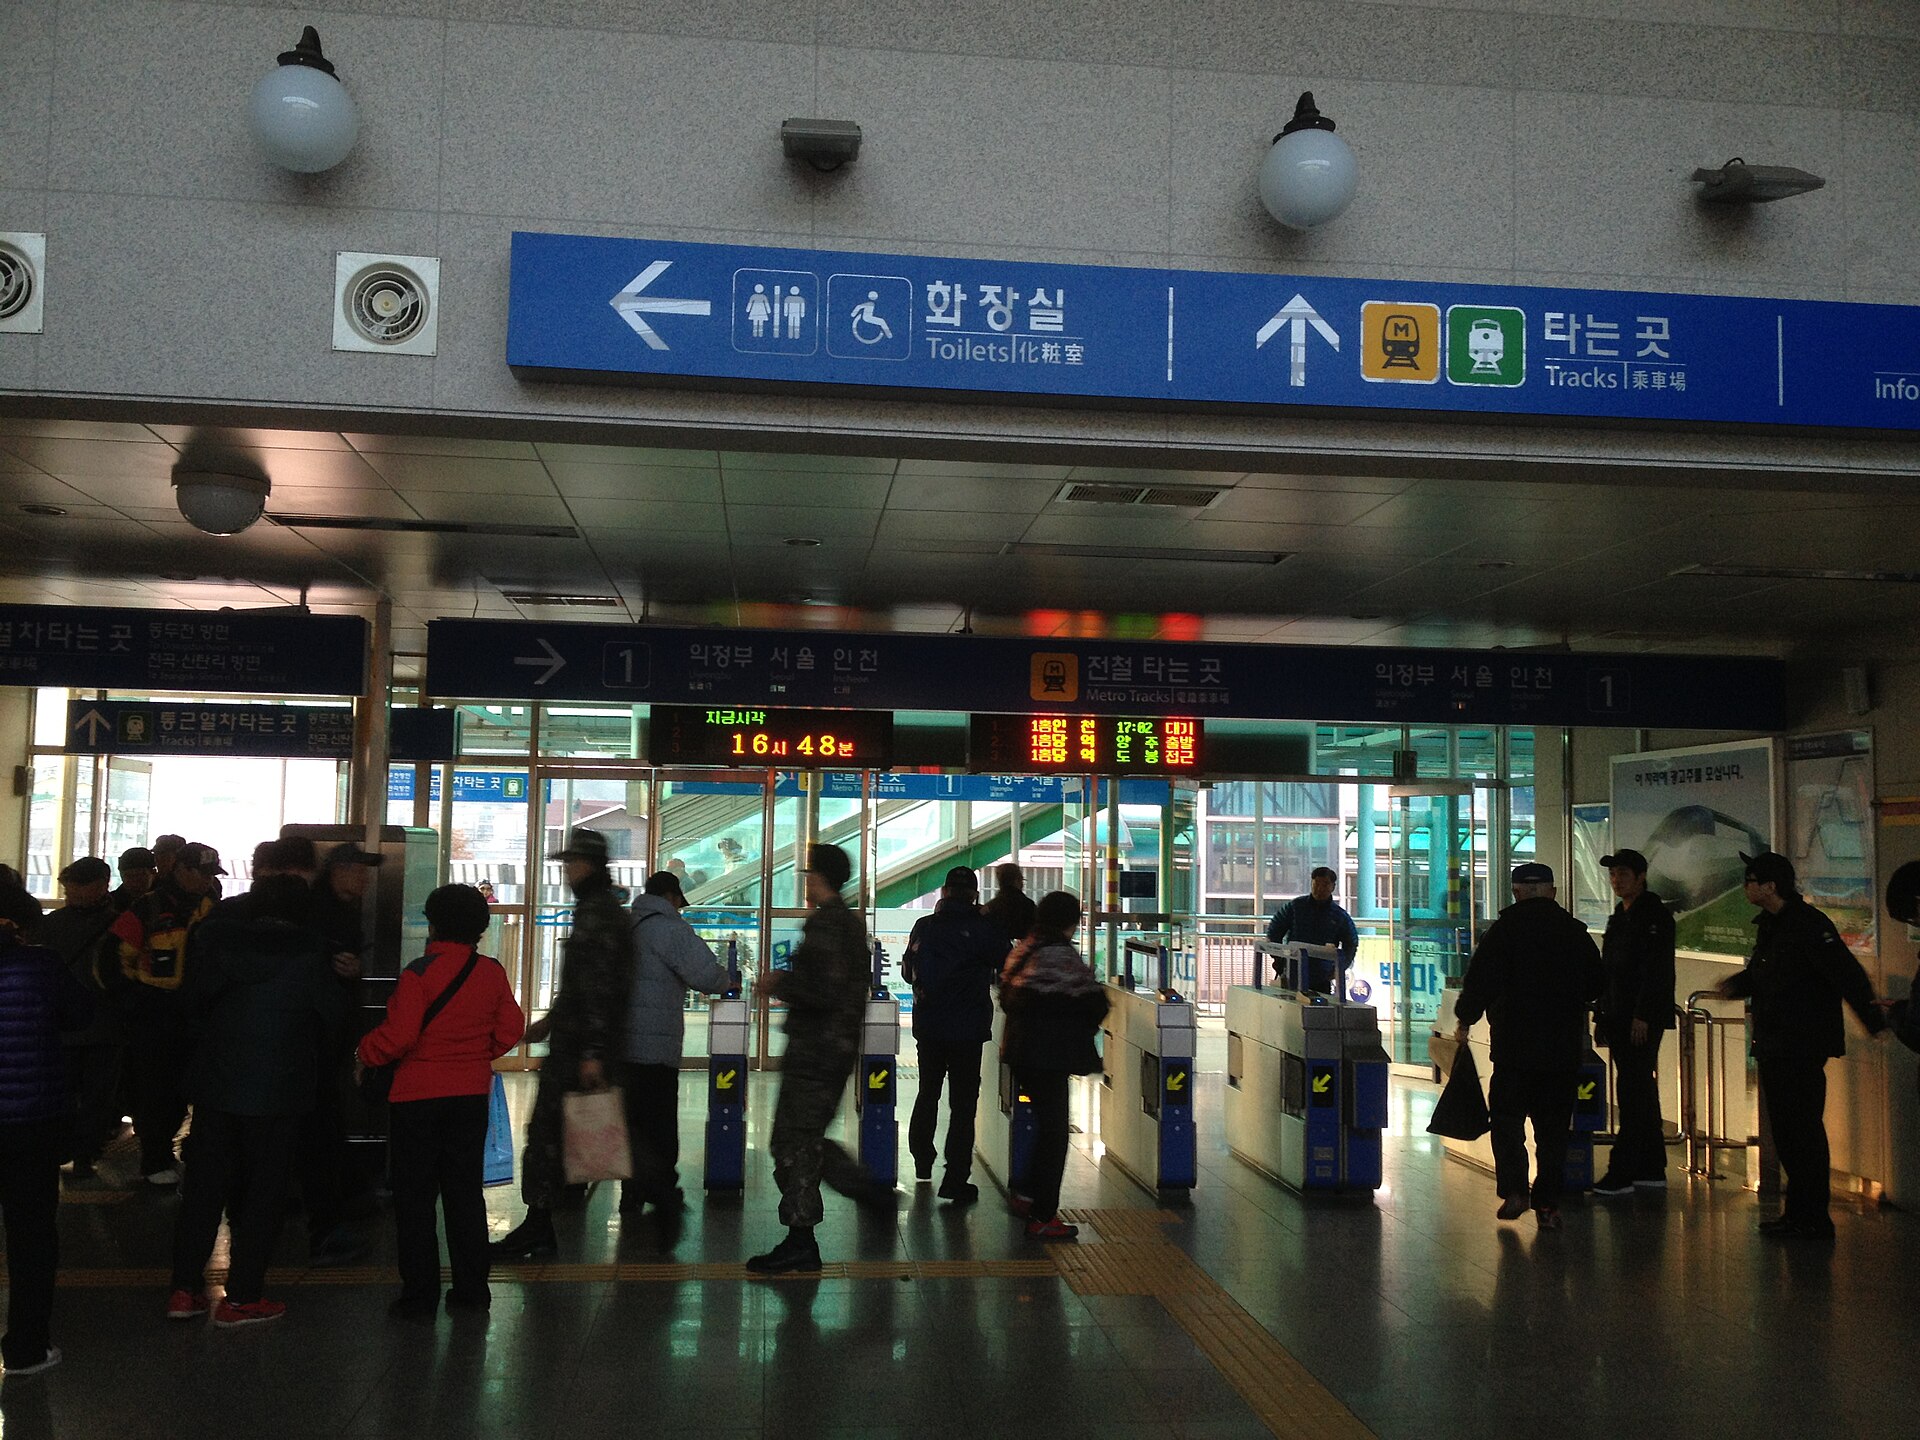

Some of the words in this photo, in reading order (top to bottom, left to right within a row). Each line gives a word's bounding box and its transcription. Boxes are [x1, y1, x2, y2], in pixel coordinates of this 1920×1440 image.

[926, 280, 1065, 332] 화장실
[1394, 322, 1409, 337] M
[1544, 312, 1620, 356] 타는
[1636, 316, 1670, 359] 곳
[926, 337, 1009, 363] Toilets
[1544, 365, 1618, 389] Tracks
[109, 624, 133, 652] 곳
[619, 648, 633, 683] 1
[689, 643, 753, 669] 의정부
[770, 646, 815, 670] 서울
[833, 648, 878, 672] 인천
[1088, 655, 1133, 682] 전철
[1143, 656, 1189, 684] 타는
[1200, 658, 1221, 684] 곳
[1375, 663, 1435, 687] 의정부
[1451, 665, 1494, 688] 서울
[1510, 667, 1553, 690] 인천
[1087, 688, 1127, 702] Metro
[1129, 689, 1170, 704] Tracks
[1599, 675, 1613, 708] 1
[706, 710, 766, 725] 지금시각
[1165, 721, 1194, 736] 대기
